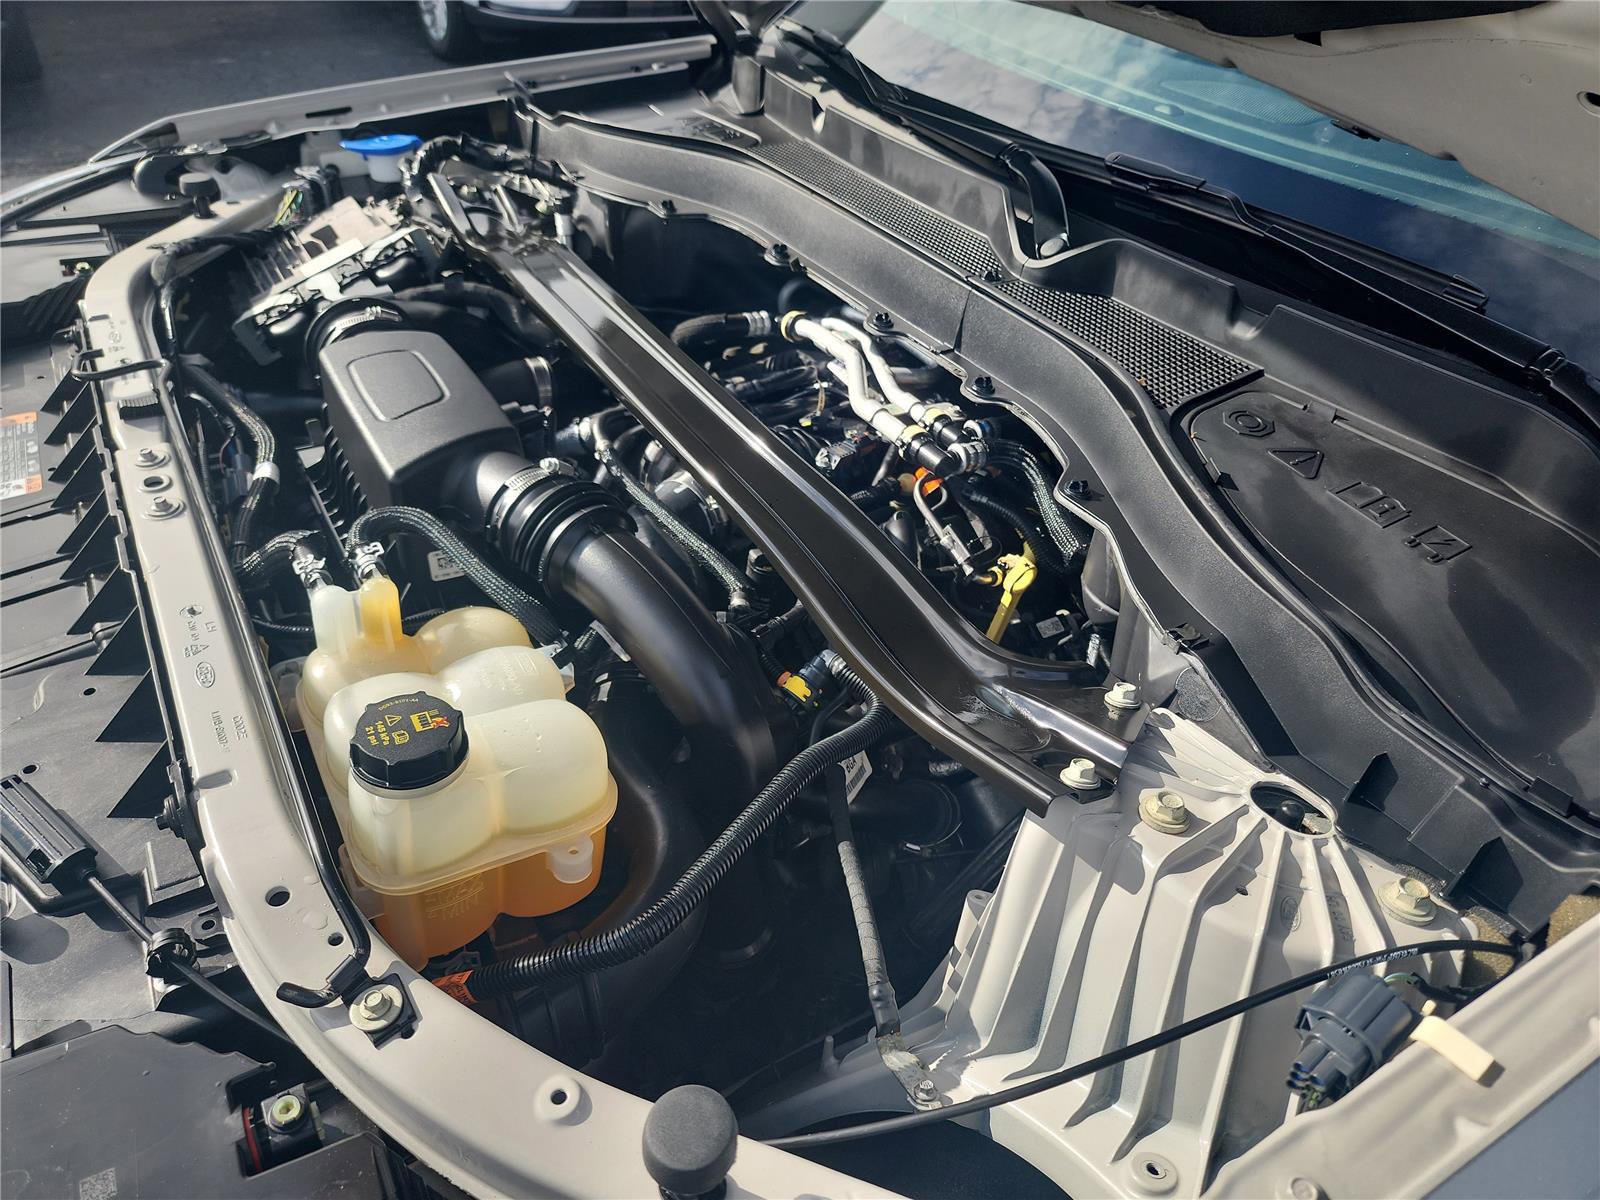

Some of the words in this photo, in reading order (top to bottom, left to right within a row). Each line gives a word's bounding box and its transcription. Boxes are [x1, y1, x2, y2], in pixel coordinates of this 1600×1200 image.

[364, 726, 375, 735] 21
[375, 720, 386, 733] 145
[366, 735, 380, 746] psi
[379, 732, 390, 746] kPa
